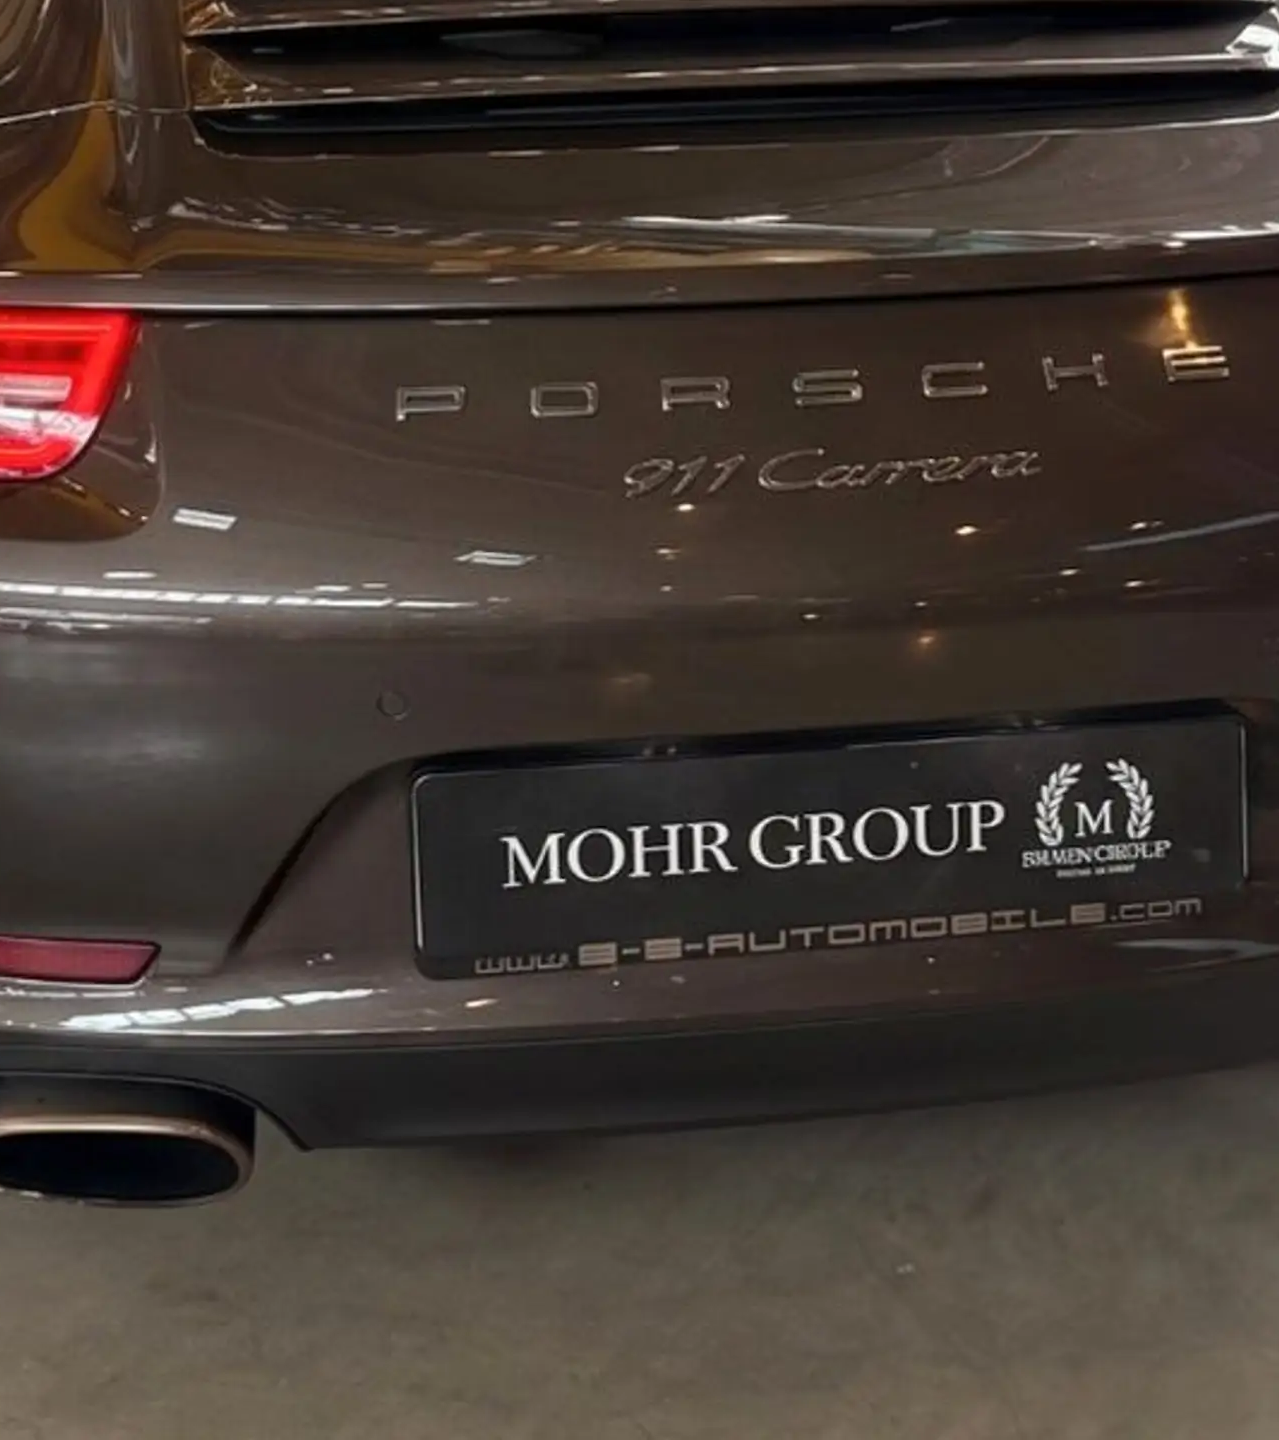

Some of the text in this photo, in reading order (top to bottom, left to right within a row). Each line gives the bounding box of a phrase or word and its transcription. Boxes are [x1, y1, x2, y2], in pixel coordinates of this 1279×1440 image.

[395, 343, 1231, 422] PORSCHE
[622, 446, 1043, 498] 911 Carrera
[500, 798, 1006, 888] MOHR GROUP
[1074, 799, 1114, 839] M
